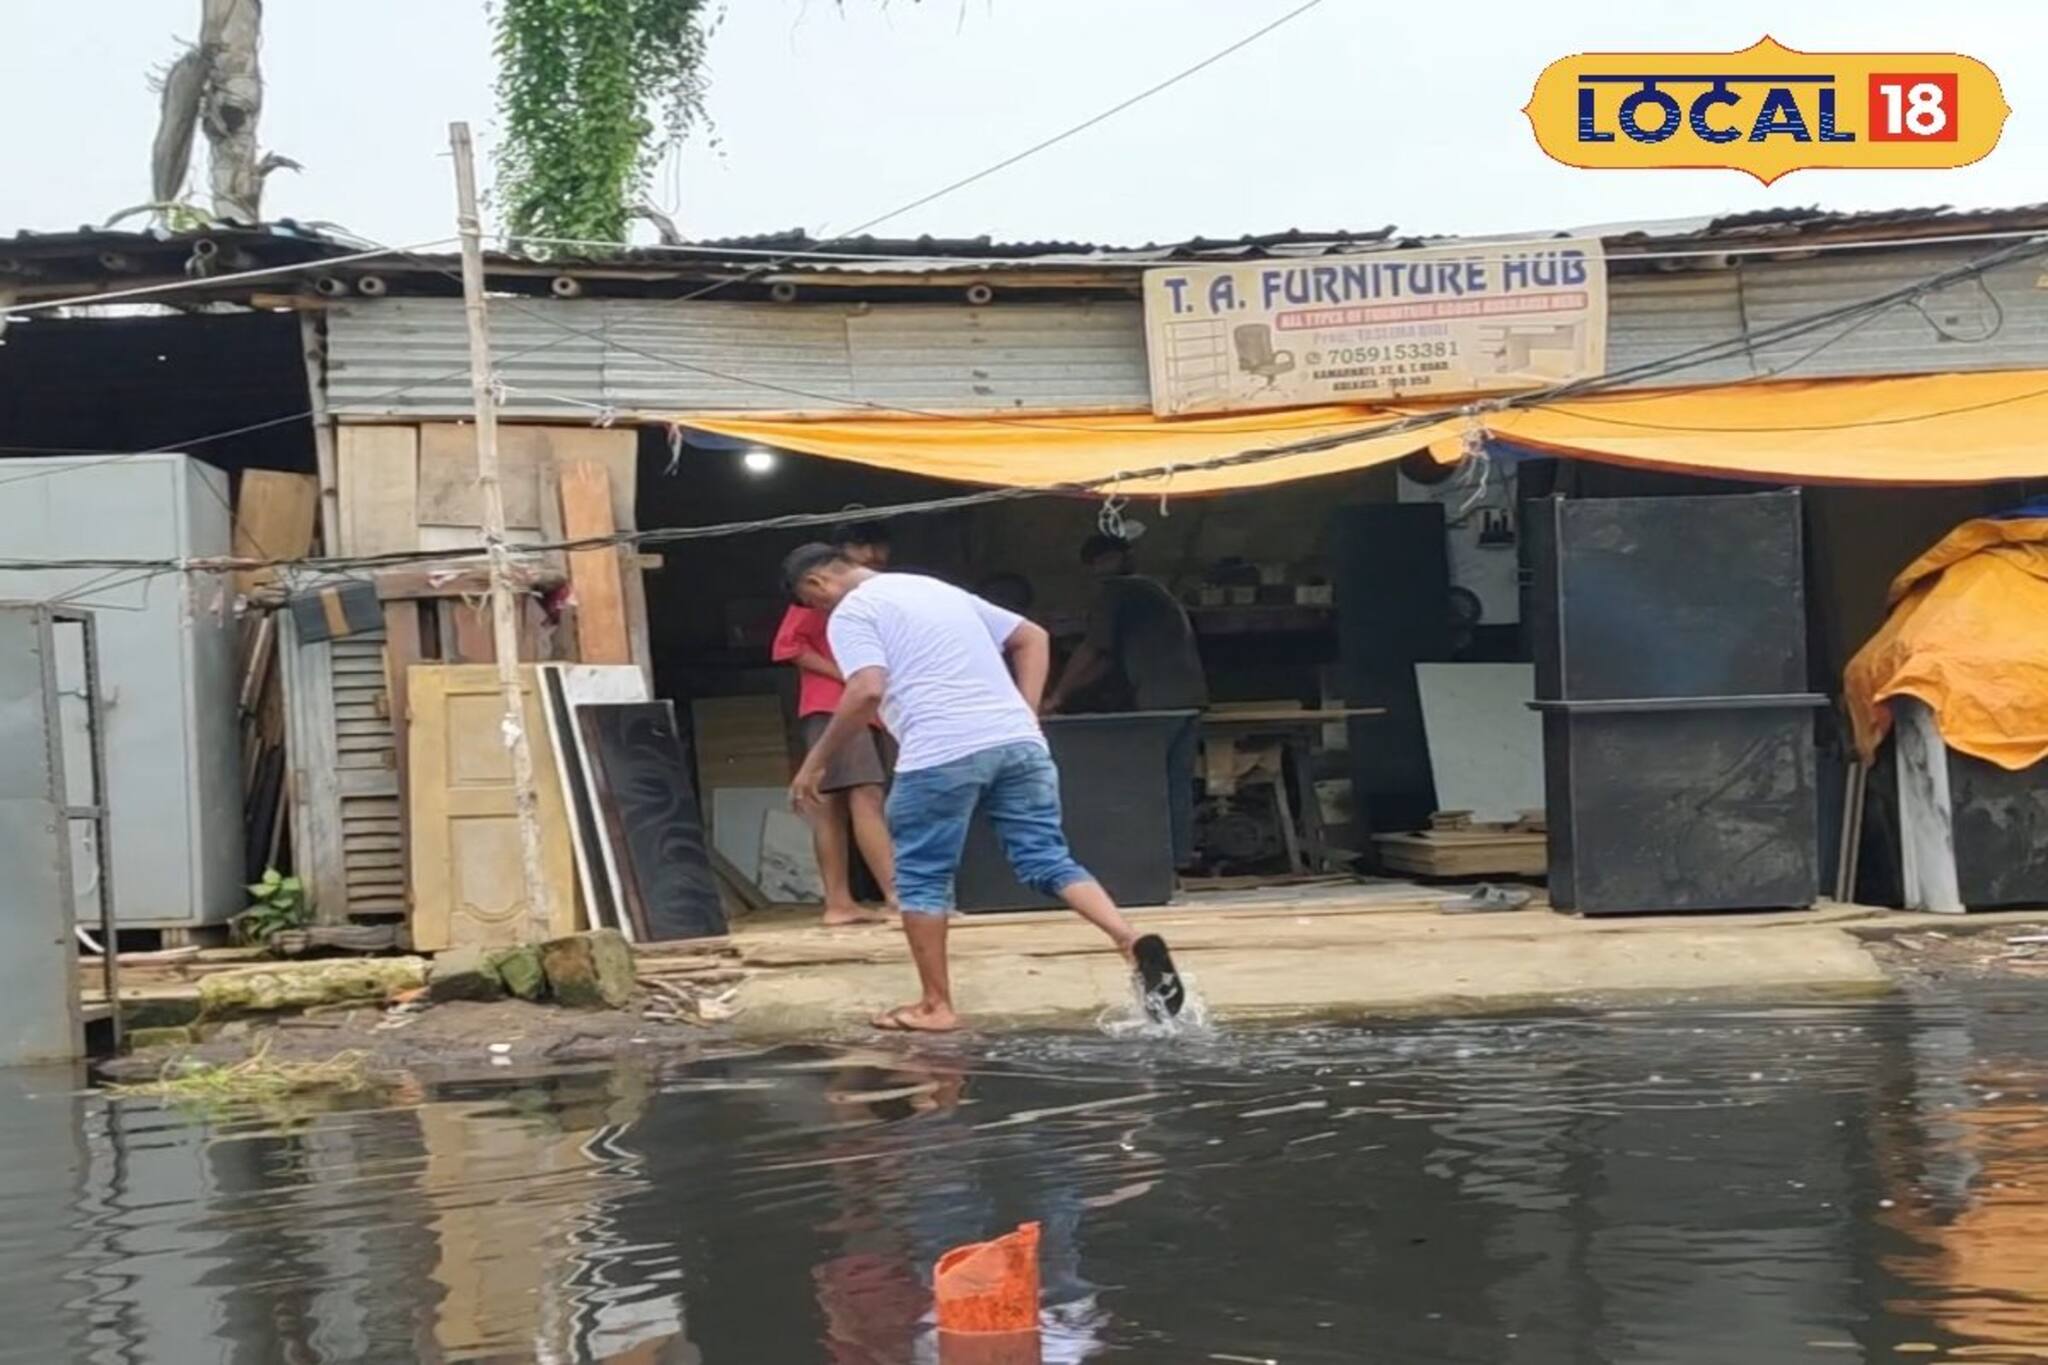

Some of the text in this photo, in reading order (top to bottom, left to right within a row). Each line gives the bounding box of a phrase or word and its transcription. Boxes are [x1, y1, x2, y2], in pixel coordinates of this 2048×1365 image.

[1164, 278, 1194, 314] T.
[1208, 275, 1246, 314] A.
[1262, 255, 1488, 311] FURNITURE
[1502, 250, 1587, 293] HUB
[1328, 341, 1459, 365] 7059153381
